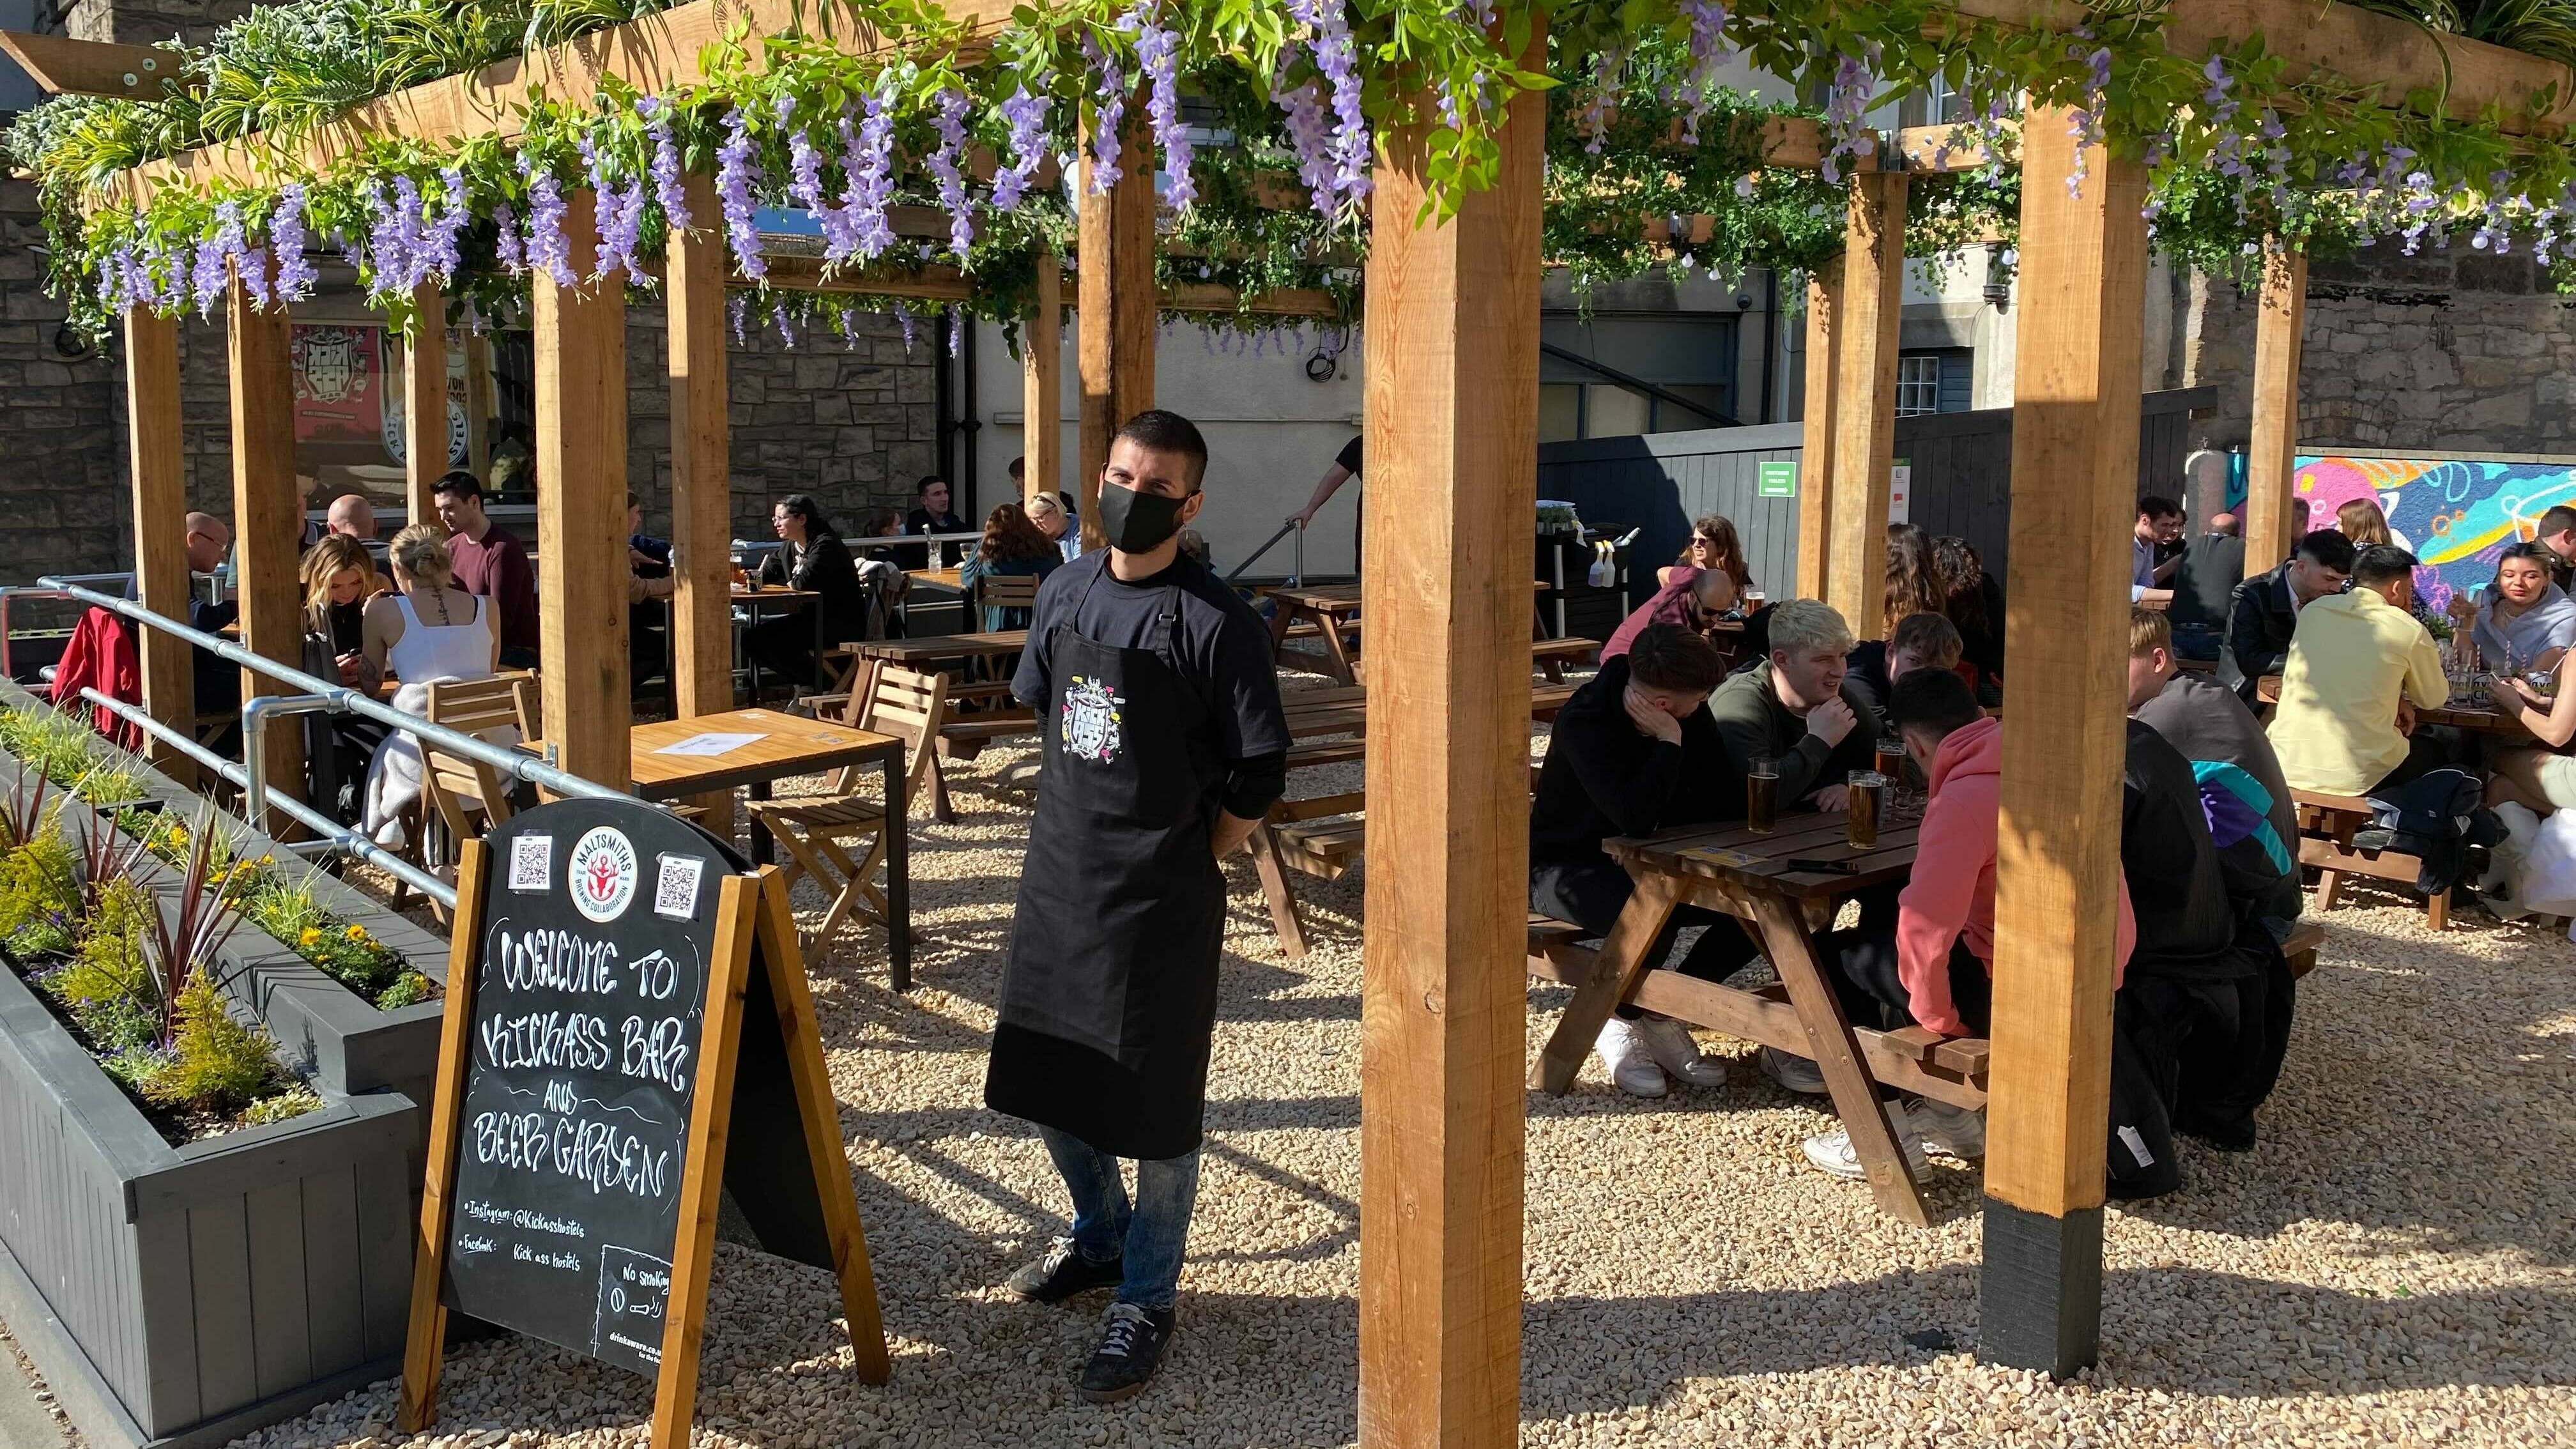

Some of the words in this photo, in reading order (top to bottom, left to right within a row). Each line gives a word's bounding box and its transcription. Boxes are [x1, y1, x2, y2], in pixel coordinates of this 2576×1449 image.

[577, 834, 631, 871] MALTSMITHS
[575, 878, 591, 907] BREWING
[590, 885, 628, 913] COLLABORATION
[502, 928, 618, 994] WELCOME
[629, 949, 679, 1000] TO
[482, 1010, 611, 1071] KICKASS
[620, 1015, 689, 1094] BAR
[544, 1079, 578, 1116] AND
[473, 1112, 549, 1172] BEER
[553, 1117, 669, 1197] GARDEN
[514, 1243, 532, 1262] Kick
[535, 1254, 549, 1265] ass
[553, 1252, 580, 1272] hostels
[610, 1332, 662, 1356] drinkaware.co.u
